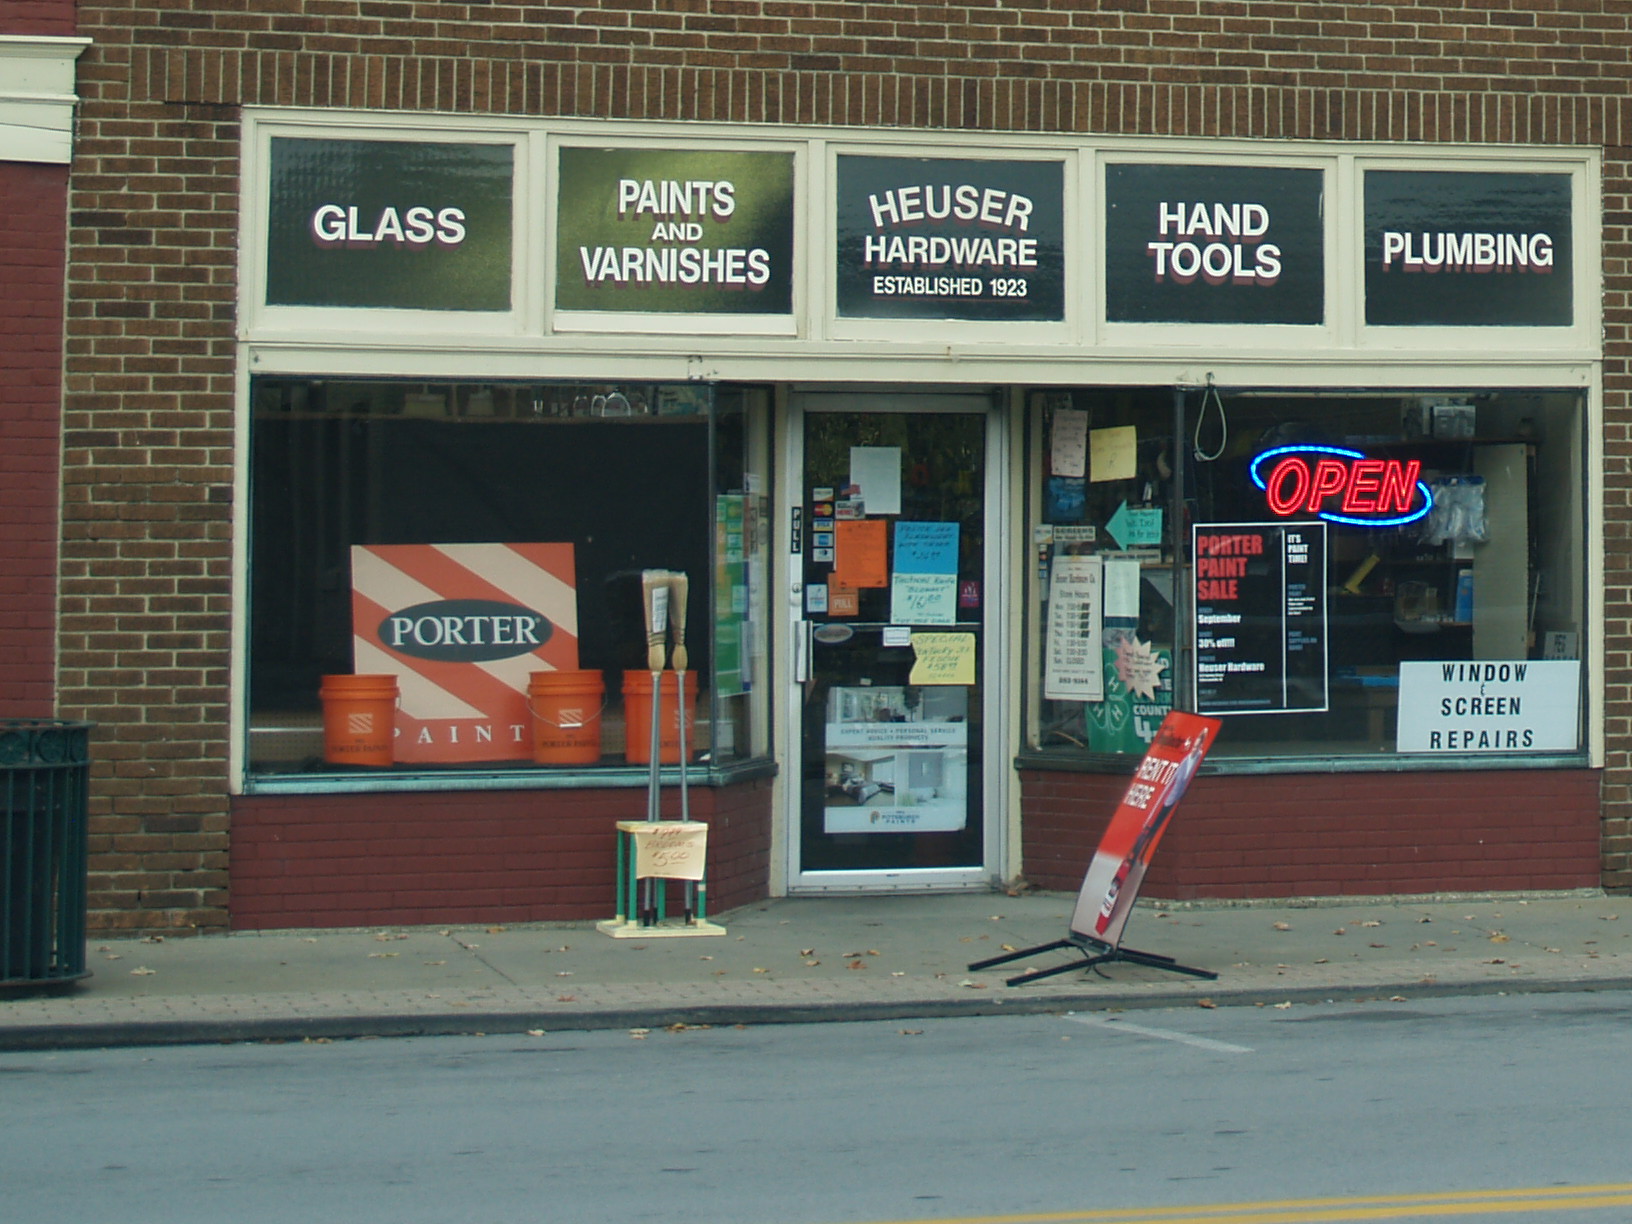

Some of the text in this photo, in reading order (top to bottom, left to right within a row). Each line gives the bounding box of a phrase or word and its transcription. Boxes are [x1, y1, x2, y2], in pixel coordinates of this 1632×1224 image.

[618, 179, 736, 218] PAINTS
[868, 184, 1034, 231] HEUSER
[312, 204, 467, 245] GLASS
[651, 222, 703, 242] AND
[1158, 201, 1270, 237] HAND
[864, 235, 1038, 267] HARDWARE
[1147, 241, 1282, 279] TOOLS
[1382, 231, 1554, 267] PLUMBING
[579, 246, 771, 285] VARNISHES
[873, 276, 1028, 297] ESTABLISHED 1923
[1266, 458, 1422, 516] OPEN
[1198, 534, 1263, 556] PORTER
[1198, 557, 1248, 578] PAINT
[1198, 579, 1239, 600] SALE
[391, 615, 541, 647] PORTER
[1198, 613, 1241, 625] September
[1198, 662, 1265, 672] Heuser Hardware
[1442, 663, 1528, 682] WINDOW
[1440, 697, 1522, 717] SCREEN
[1430, 728, 1534, 749] REPAIRS
[1135, 756, 1169, 783] RENT
